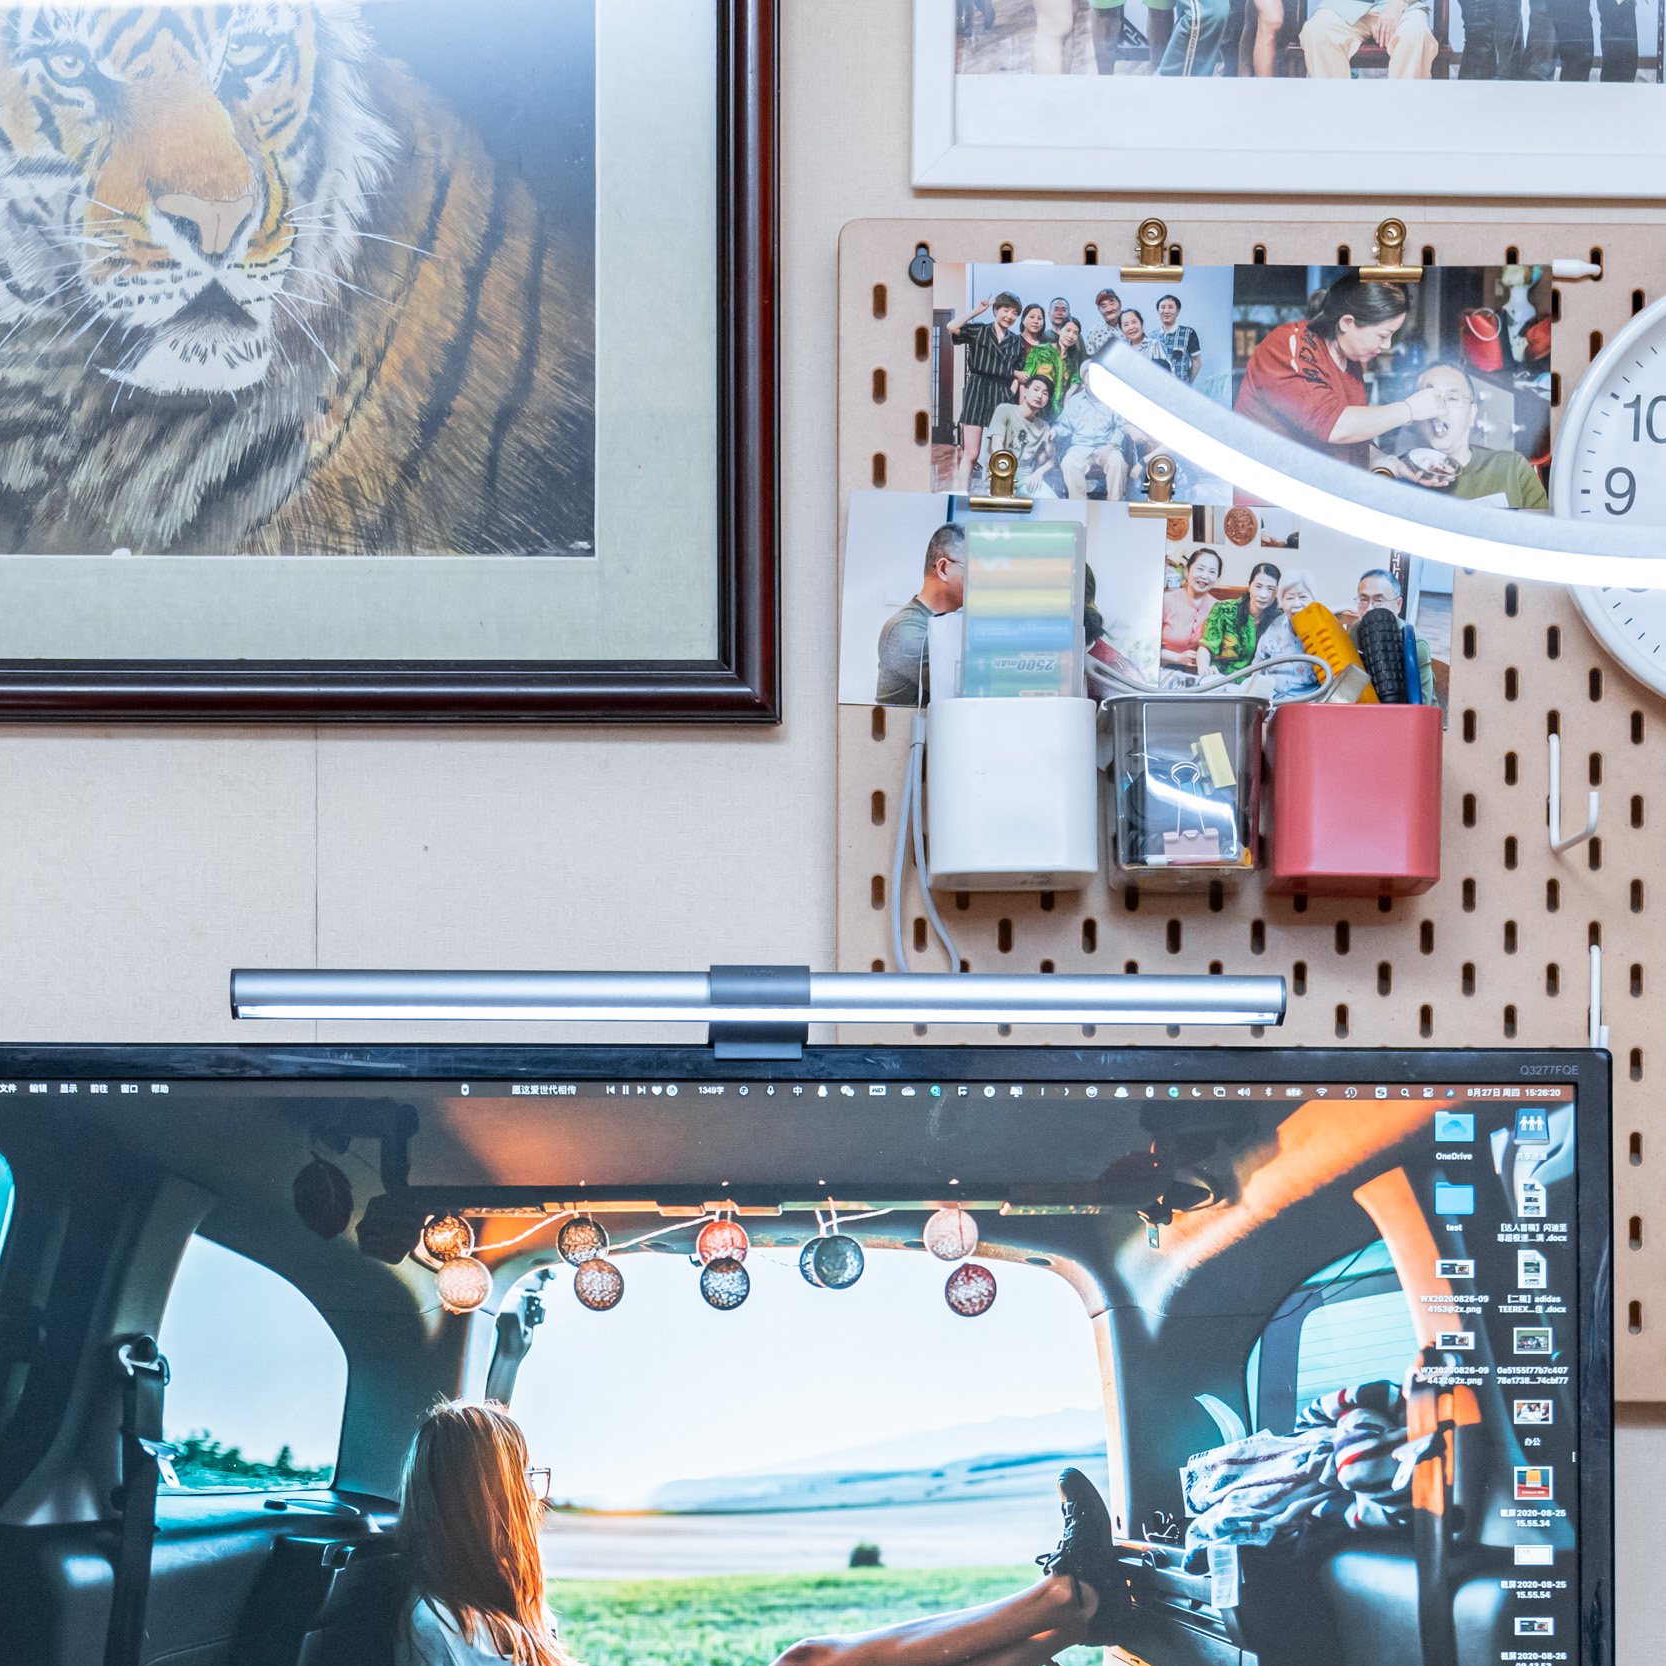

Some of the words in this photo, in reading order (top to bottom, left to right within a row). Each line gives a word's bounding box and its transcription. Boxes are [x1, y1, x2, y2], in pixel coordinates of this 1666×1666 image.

[1604, 467, 1637, 515] 9
[991, 658, 1056, 672] 2500mAh
[1519, 1065, 1579, 1076] Q3277FQE
[0, 1084, 18, 1094] 文件
[1467, 1088, 1501, 1098] 8月27日
[1502, 1088, 1521, 1098] 周四
[1525, 1088, 1561, 1097] 15:26:20
[1436, 1152, 1473, 1160] OneDrive
[1524, 1437, 1541, 1446] 办公
